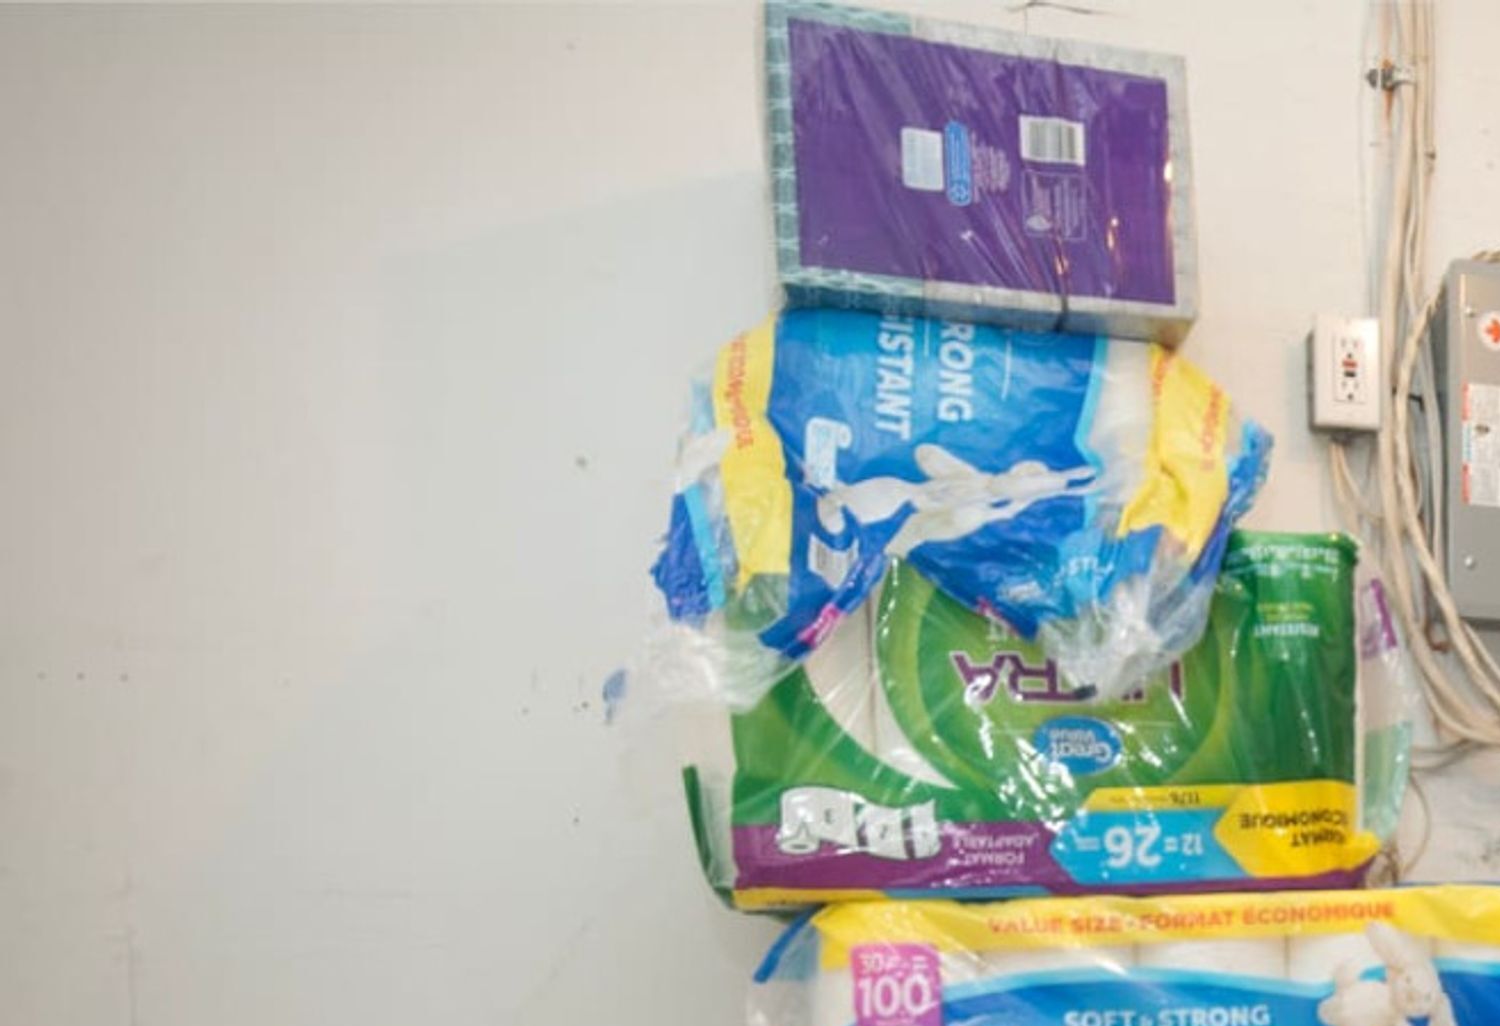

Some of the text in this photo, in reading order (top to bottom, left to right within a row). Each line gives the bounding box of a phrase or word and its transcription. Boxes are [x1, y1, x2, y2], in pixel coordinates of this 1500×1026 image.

[1050, 742, 1114, 761] Great
[1103, 825, 1163, 868] 26
[1181, 832, 1204, 857] 12
[987, 901, 1396, 935] VALUE SIZE FORMAT ÉCONOMIQUE
[857, 973, 934, 1018] 100
